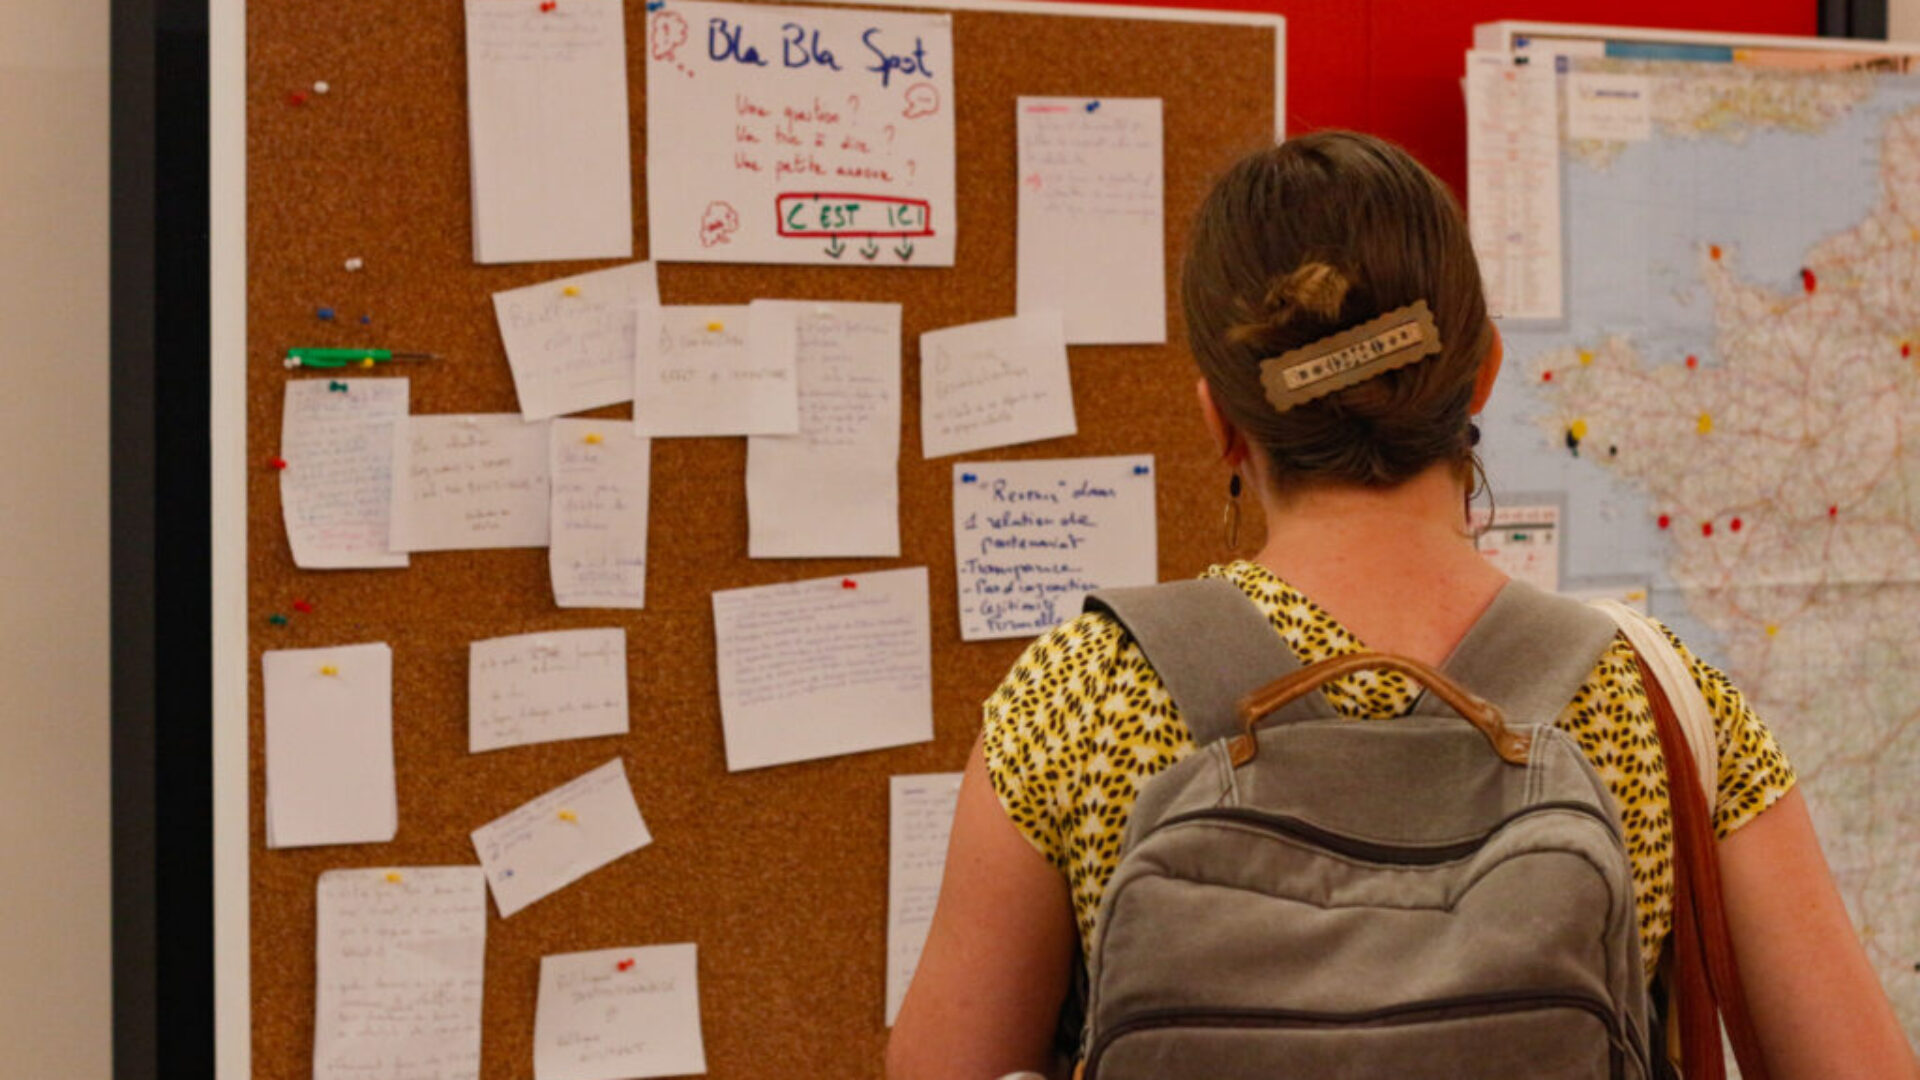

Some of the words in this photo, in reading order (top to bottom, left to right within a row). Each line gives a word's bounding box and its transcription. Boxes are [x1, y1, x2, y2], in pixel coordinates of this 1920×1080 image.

[708, 18, 768, 64] Bla
[782, 23, 842, 71] Bla
[863, 27, 933, 87] Spot
[736, 94, 770, 117] Une
[848, 94, 860, 126] ?
[884, 124, 896, 155] ?
[735, 151, 762, 171] Une
[776, 155, 827, 181] petite
[906, 159, 917, 187] ?
[888, 205, 923, 227] ICI
[987, 510, 1054, 529] relation
[981, 533, 1085, 555] partenariat
